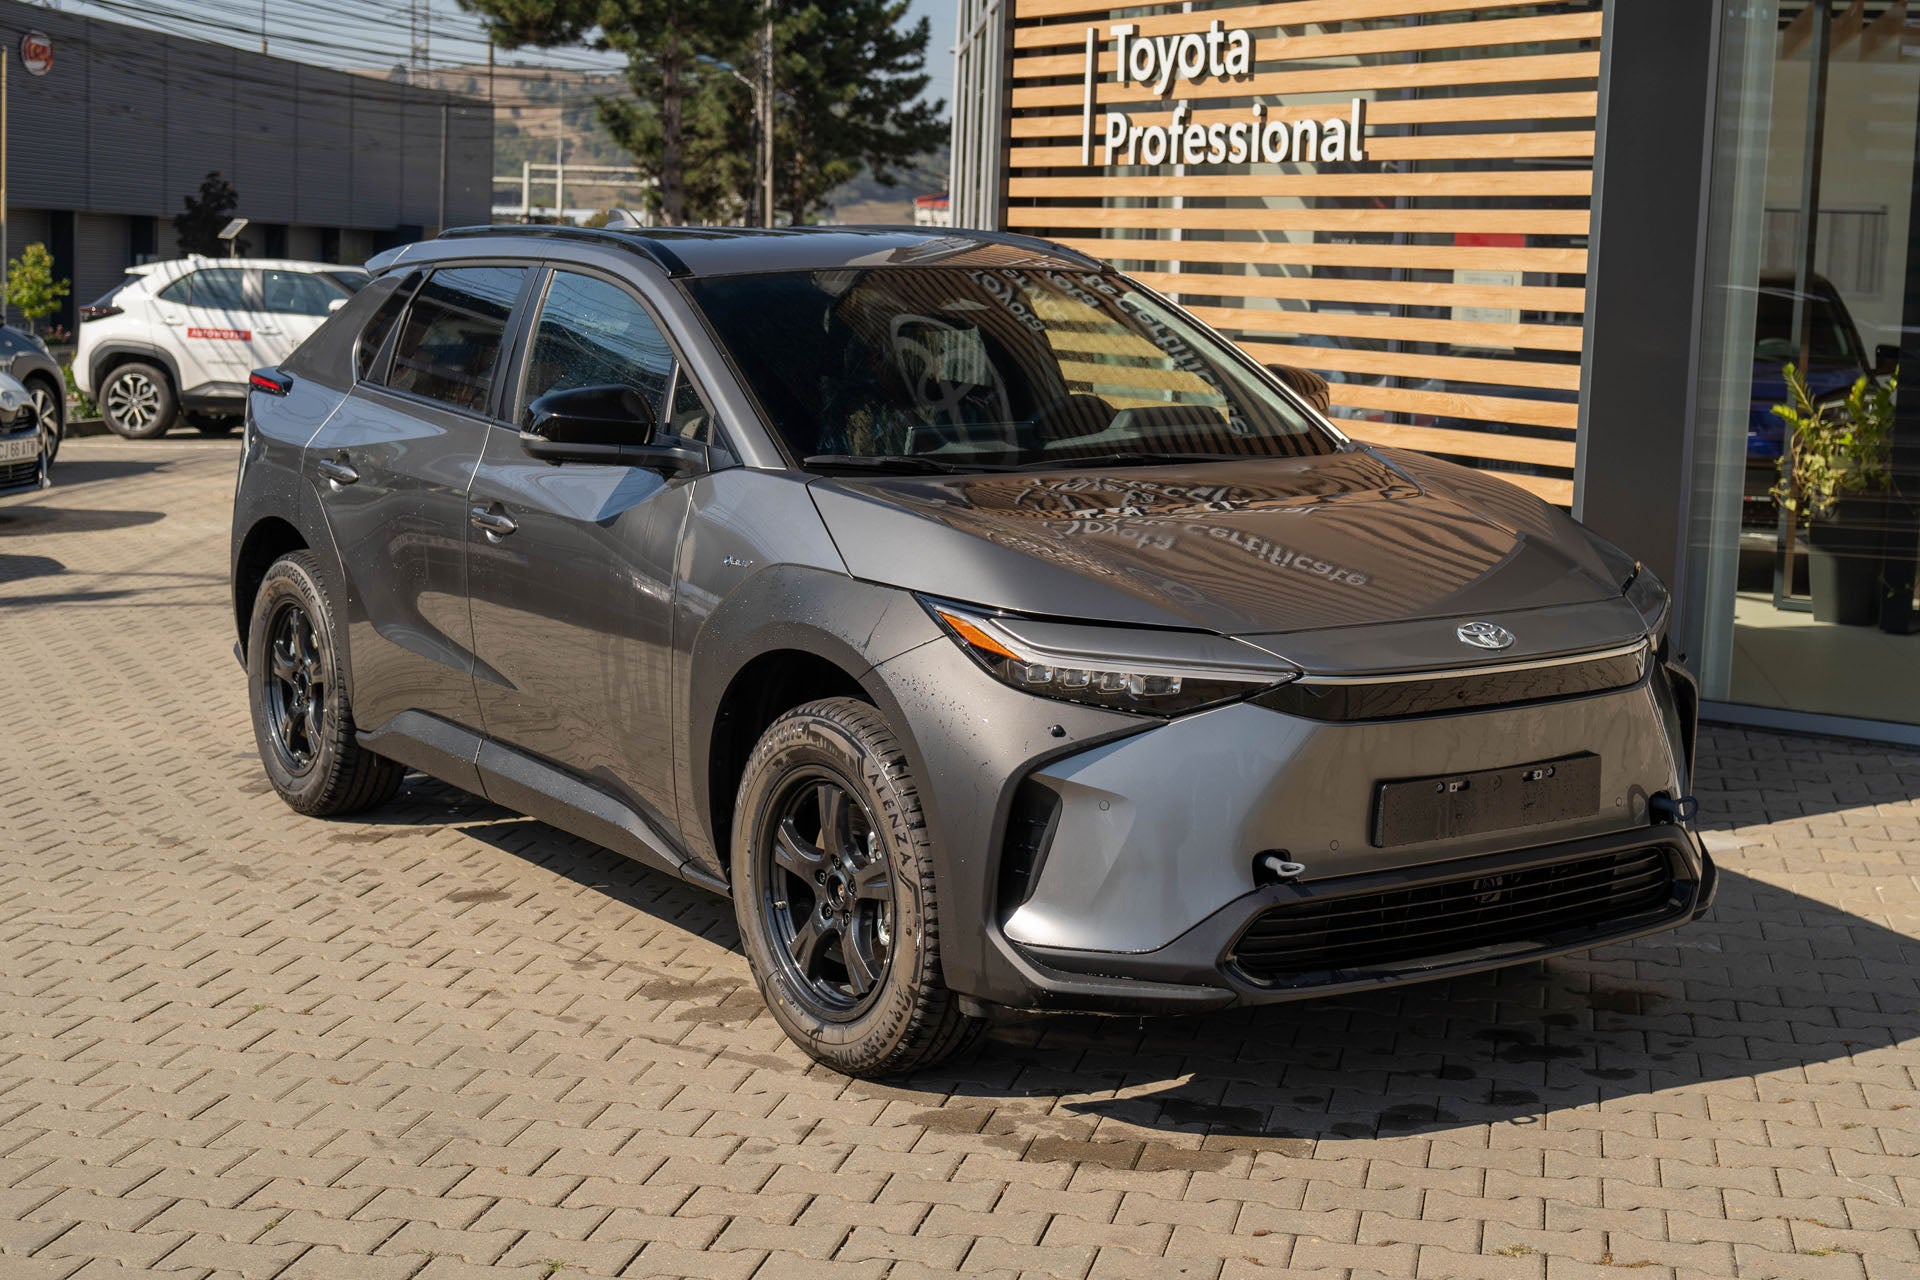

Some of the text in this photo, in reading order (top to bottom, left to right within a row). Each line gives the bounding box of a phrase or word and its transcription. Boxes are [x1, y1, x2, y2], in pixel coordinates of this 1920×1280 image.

[1110, 20, 1251, 95] Toyota
[1105, 98, 1363, 165] Professional
[868, 773, 913, 868] ALENZA
